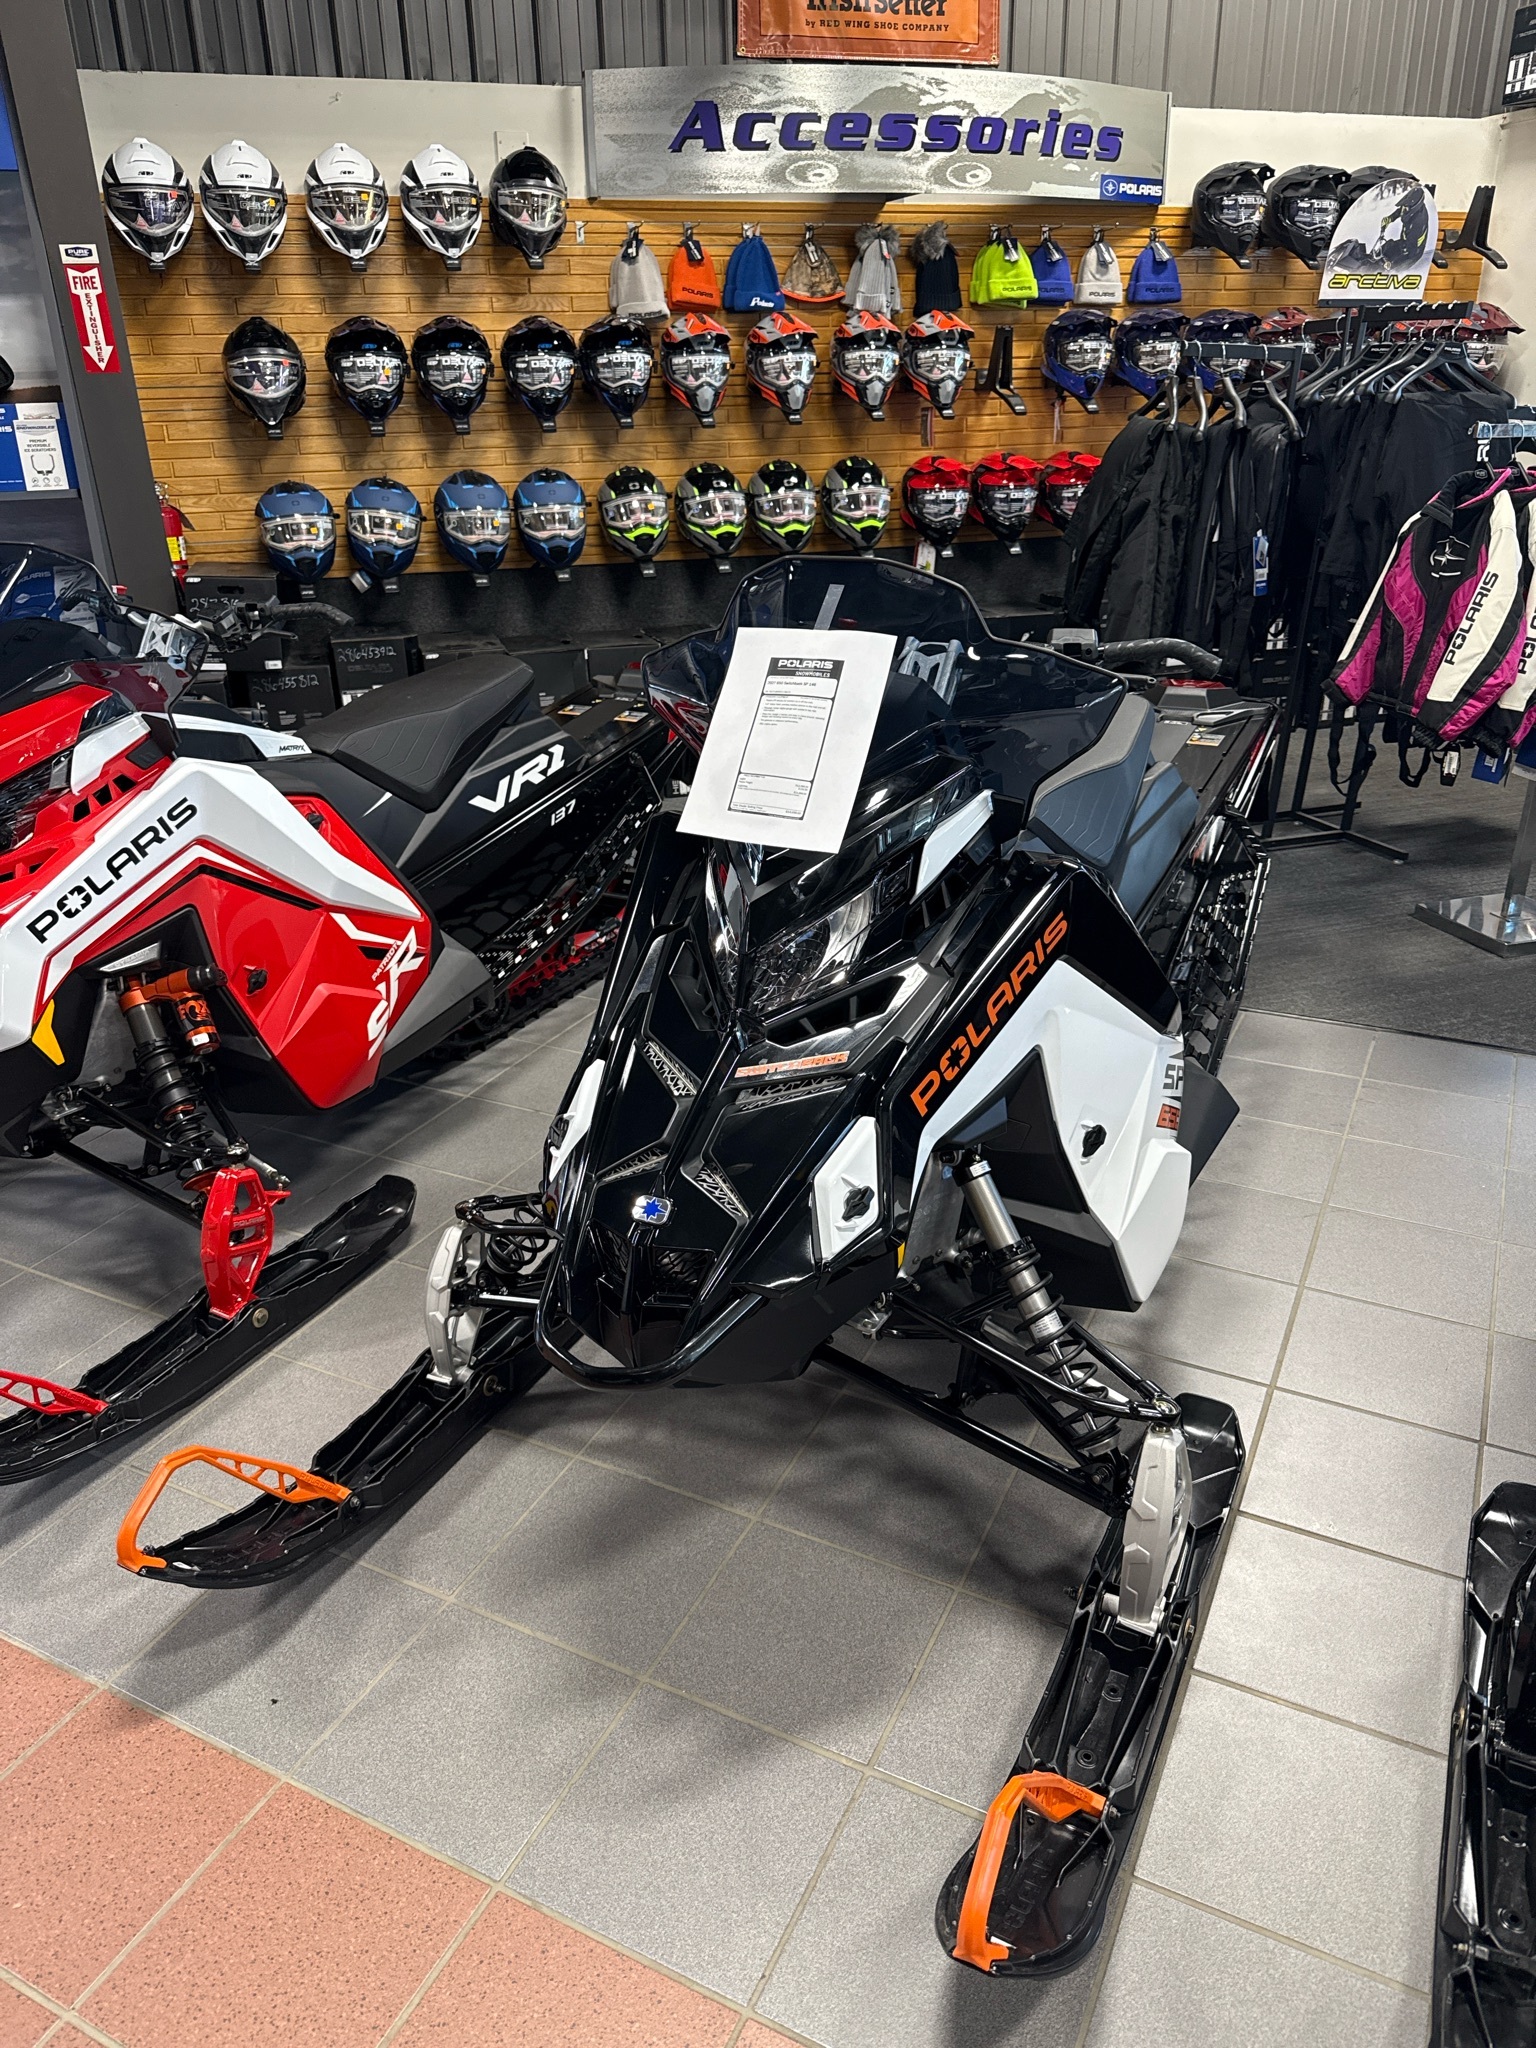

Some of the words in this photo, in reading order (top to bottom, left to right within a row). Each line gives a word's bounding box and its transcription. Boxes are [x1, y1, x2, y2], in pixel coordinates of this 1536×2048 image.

[805, 19, 816, 28] by
[819, 19, 840, 28] RED
[844, 20, 871, 29] WING
[874, 21, 899, 31] SHOE
[902, 23, 949, 31] COMPANY
[667, 100, 1124, 162] Accessories
[1118, 183, 1163, 197] POLARIS
[72, 275, 98, 290] FIRE
[1328, 272, 1422, 290] arctiva
[682, 286, 714, 299] POLARIS
[1002, 286, 1033, 294] POLARIS
[628, 310, 663, 320] POLARIS
[85, 292, 105, 364] EXTINGUISHER
[1444, 572, 1499, 665] POLARIS
[778, 659, 834, 670] POLARIS
[278, 744, 306, 753] MATRYX
[550, 799, 577, 827] 137
[25, 796, 198, 944] POLARIS
[371, 941, 399, 982] PATRIOT
[910, 910, 1068, 1118] POLARIS
[233, 1215, 266, 1228] POLARIS
